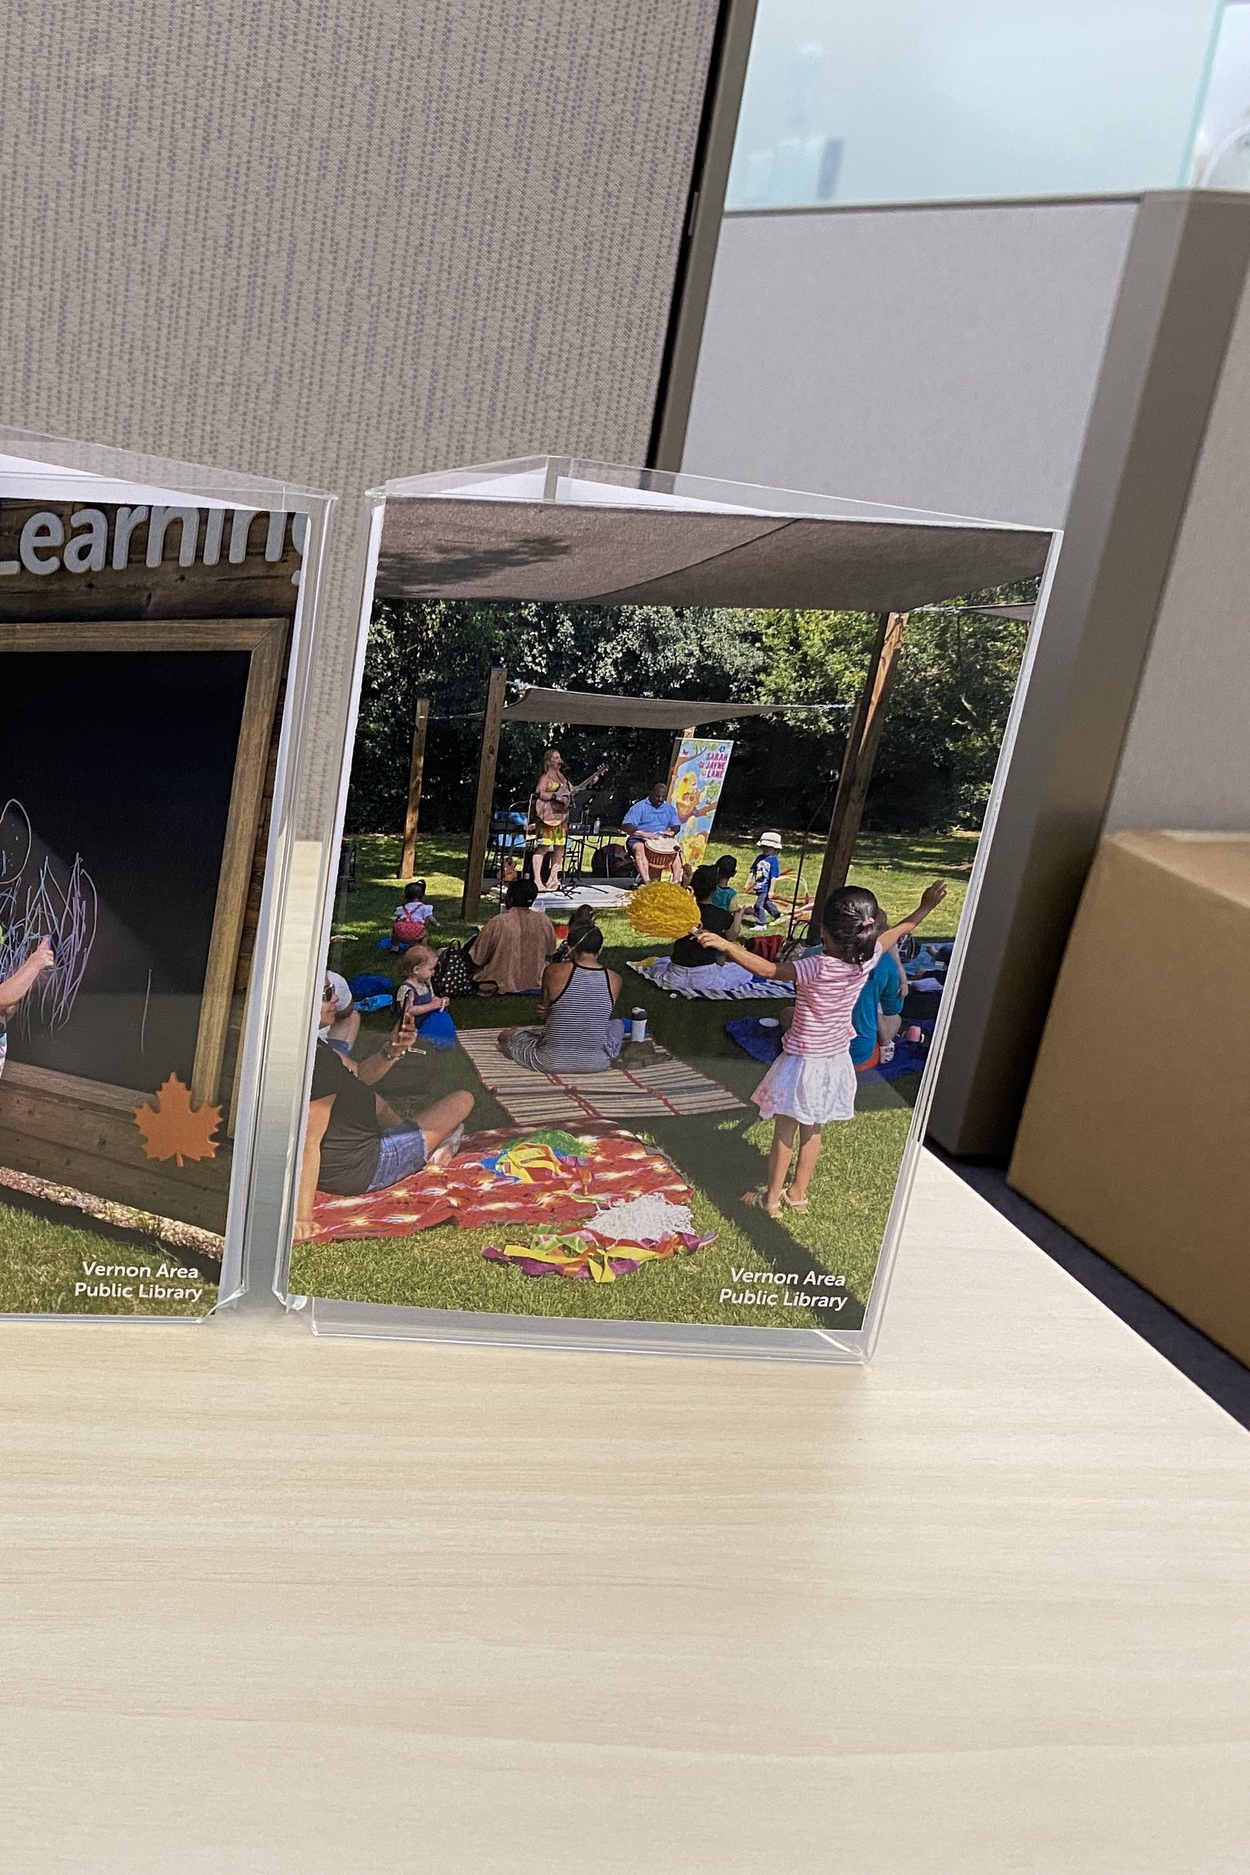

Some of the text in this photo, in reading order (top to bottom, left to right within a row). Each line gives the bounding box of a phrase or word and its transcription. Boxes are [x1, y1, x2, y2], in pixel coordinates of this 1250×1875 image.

[706, 761, 726, 770] JAYNE
[707, 752, 728, 761] SARAH
[707, 770, 724, 778] LANE
[82, 1261, 199, 1279] Vernon Area
[730, 1267, 846, 1287] Vernon Area
[74, 1281, 203, 1303] Public Library
[719, 1288, 848, 1312] Public Library
